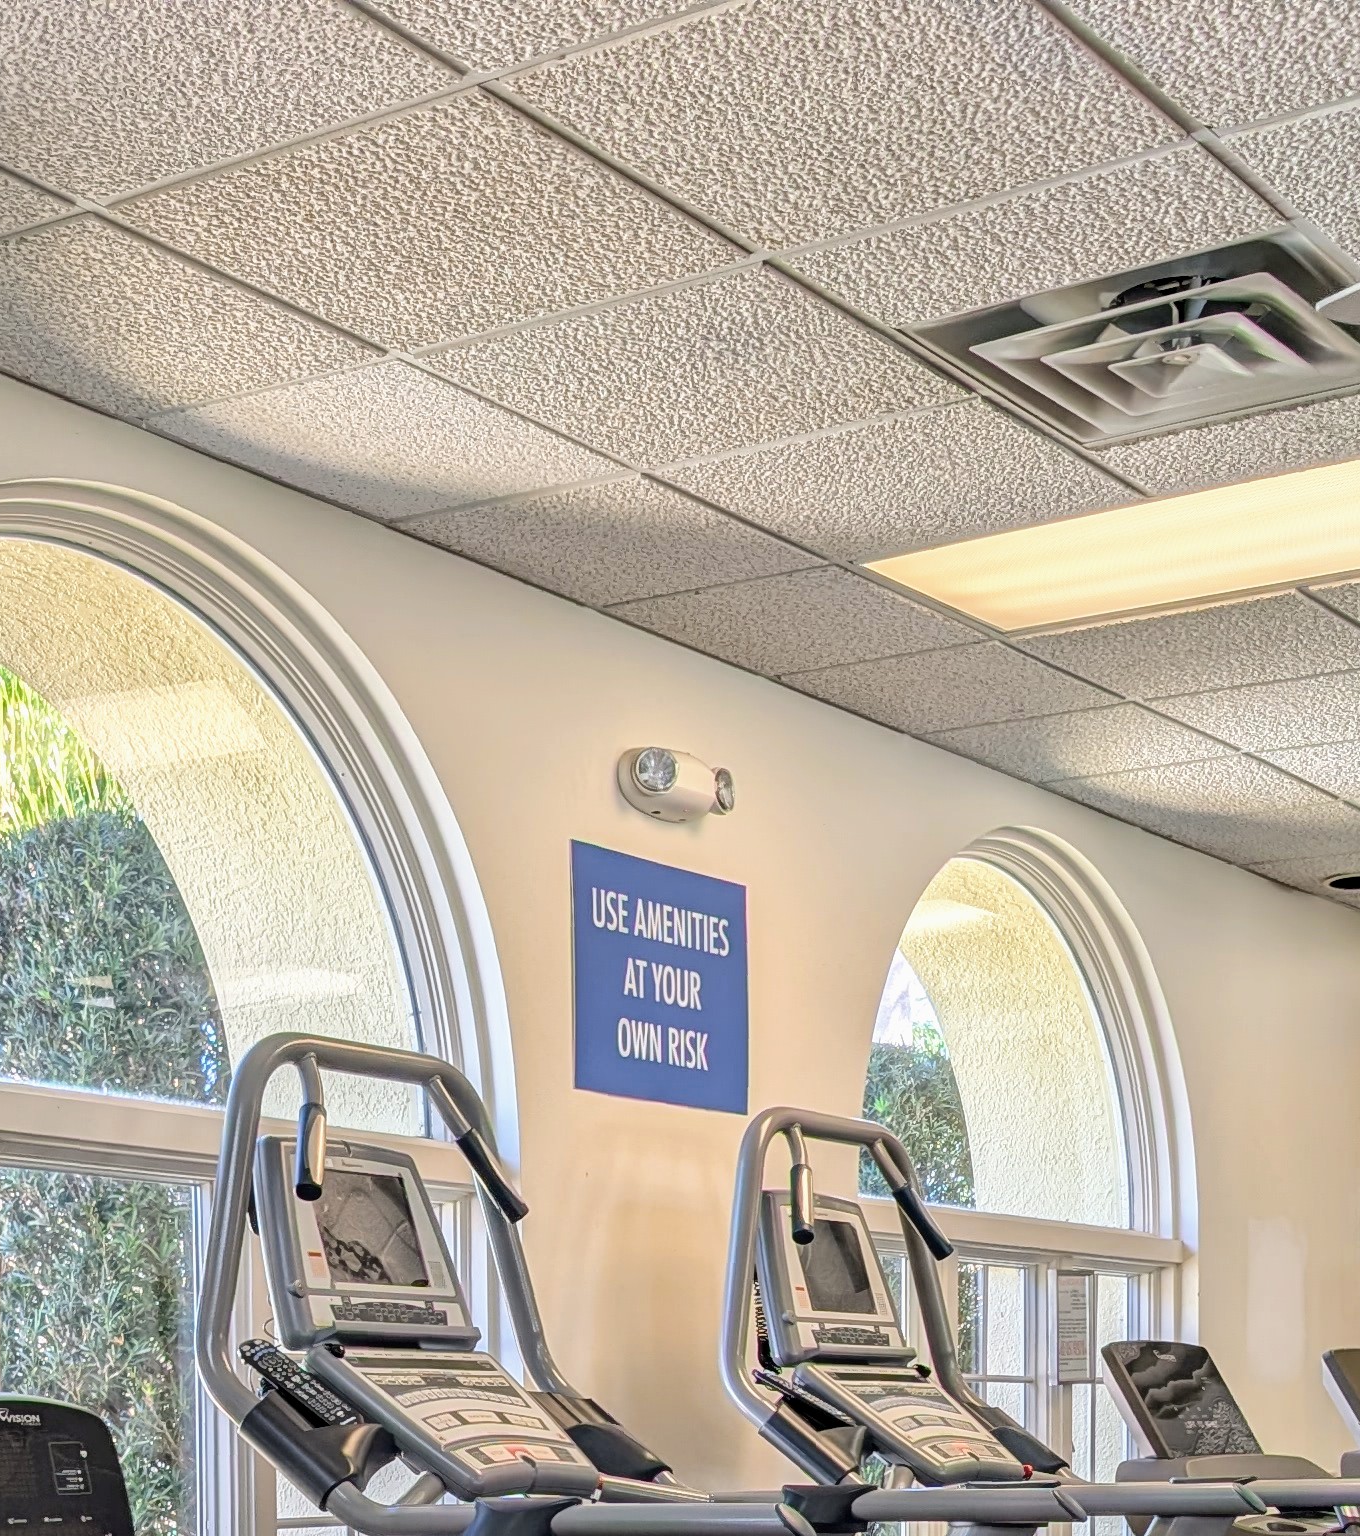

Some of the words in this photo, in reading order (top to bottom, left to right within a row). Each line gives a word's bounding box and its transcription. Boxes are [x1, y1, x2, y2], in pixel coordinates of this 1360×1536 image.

[592, 887, 629, 934] USE
[634, 898, 730, 957] AMENITIES
[623, 957, 648, 999] AT
[651, 962, 702, 1011] YOUR
[617, 1017, 662, 1063] OWN
[668, 1026, 709, 1071] RISK
